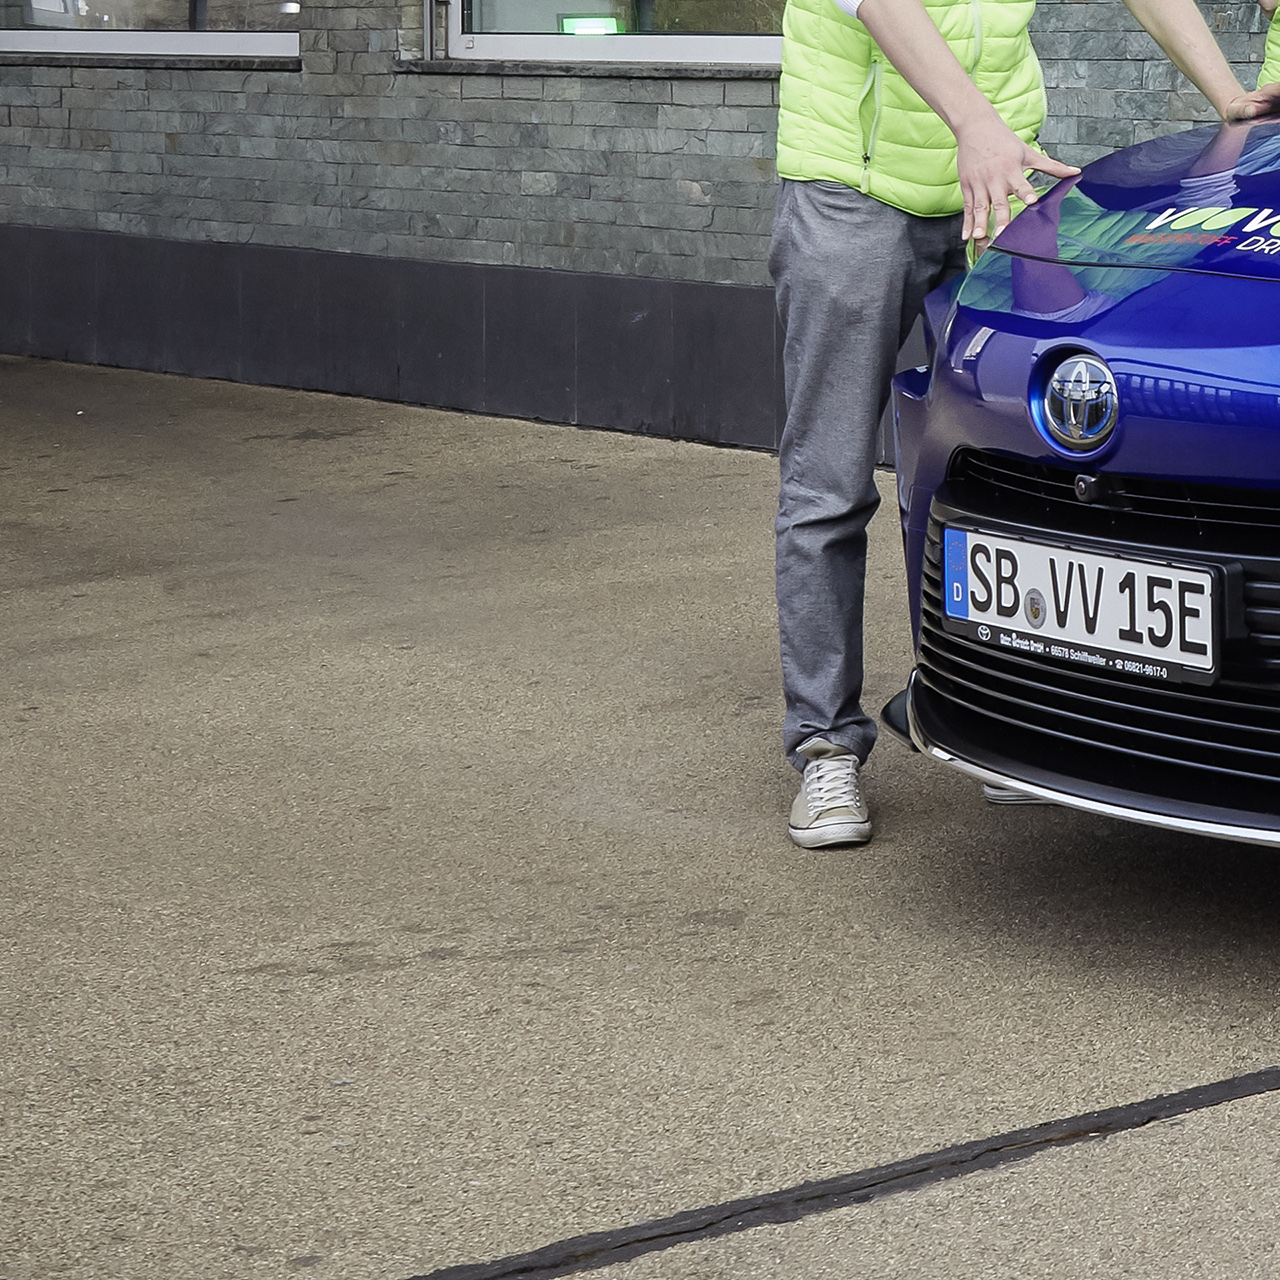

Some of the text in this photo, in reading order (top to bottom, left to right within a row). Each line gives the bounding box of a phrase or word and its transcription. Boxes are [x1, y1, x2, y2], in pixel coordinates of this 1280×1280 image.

[953, 582, 962, 602] D
[970, 543, 1208, 657] SB VV 15E
